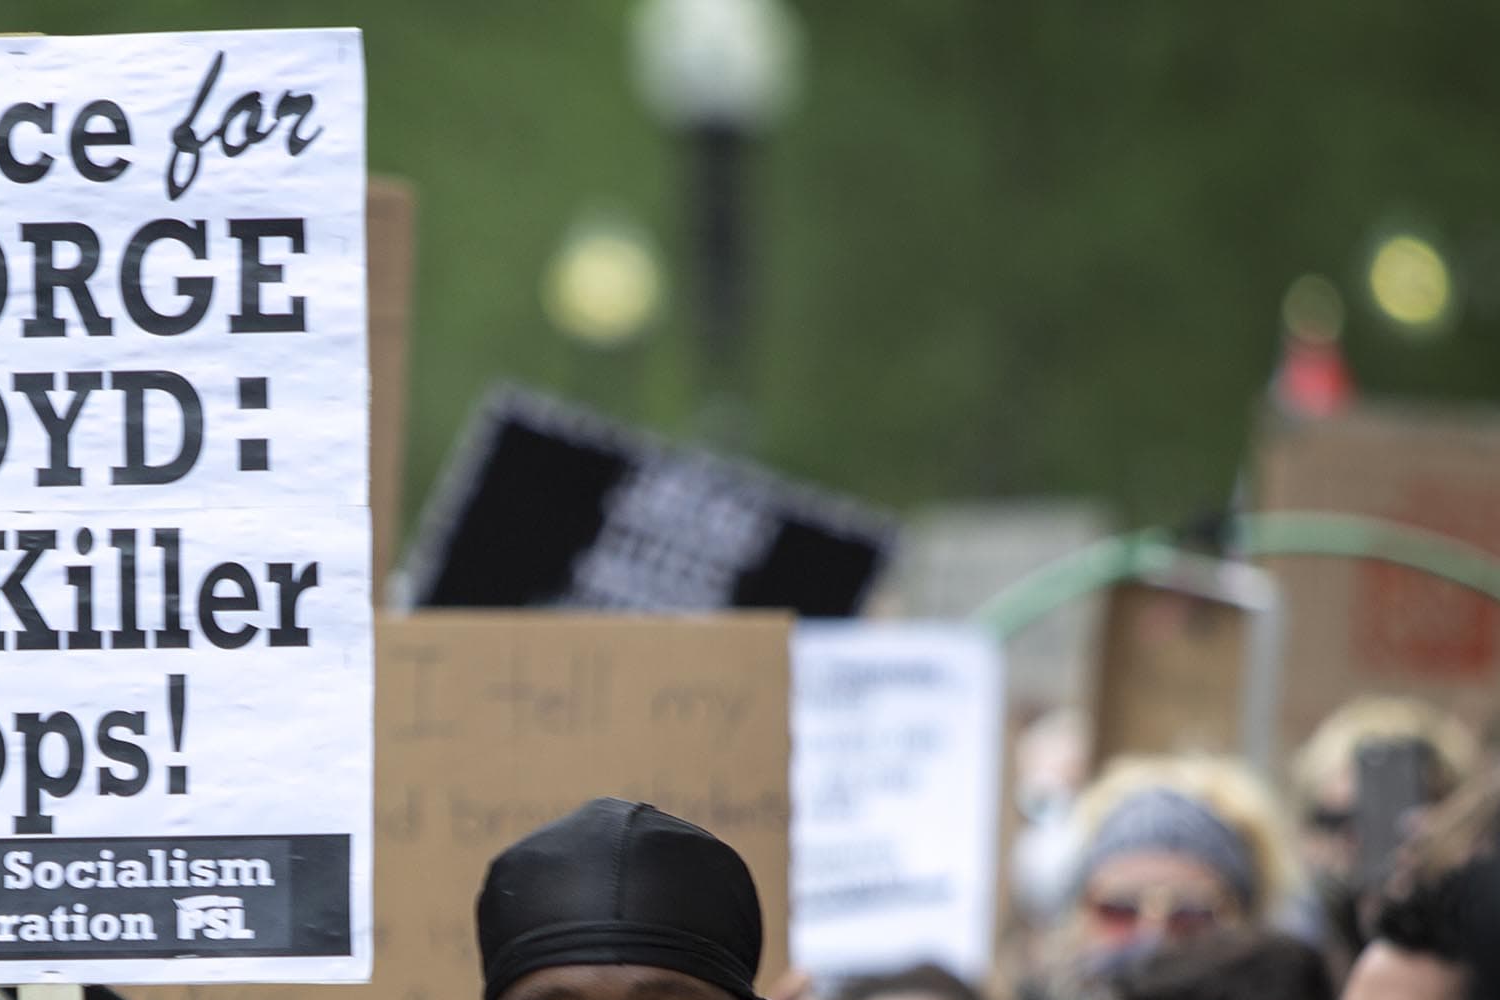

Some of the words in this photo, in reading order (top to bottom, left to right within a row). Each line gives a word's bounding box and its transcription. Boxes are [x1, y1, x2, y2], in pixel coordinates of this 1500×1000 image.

[167, 52, 320, 201] for
[3, 848, 275, 890] Socialism
[174, 896, 254, 941] PSL
